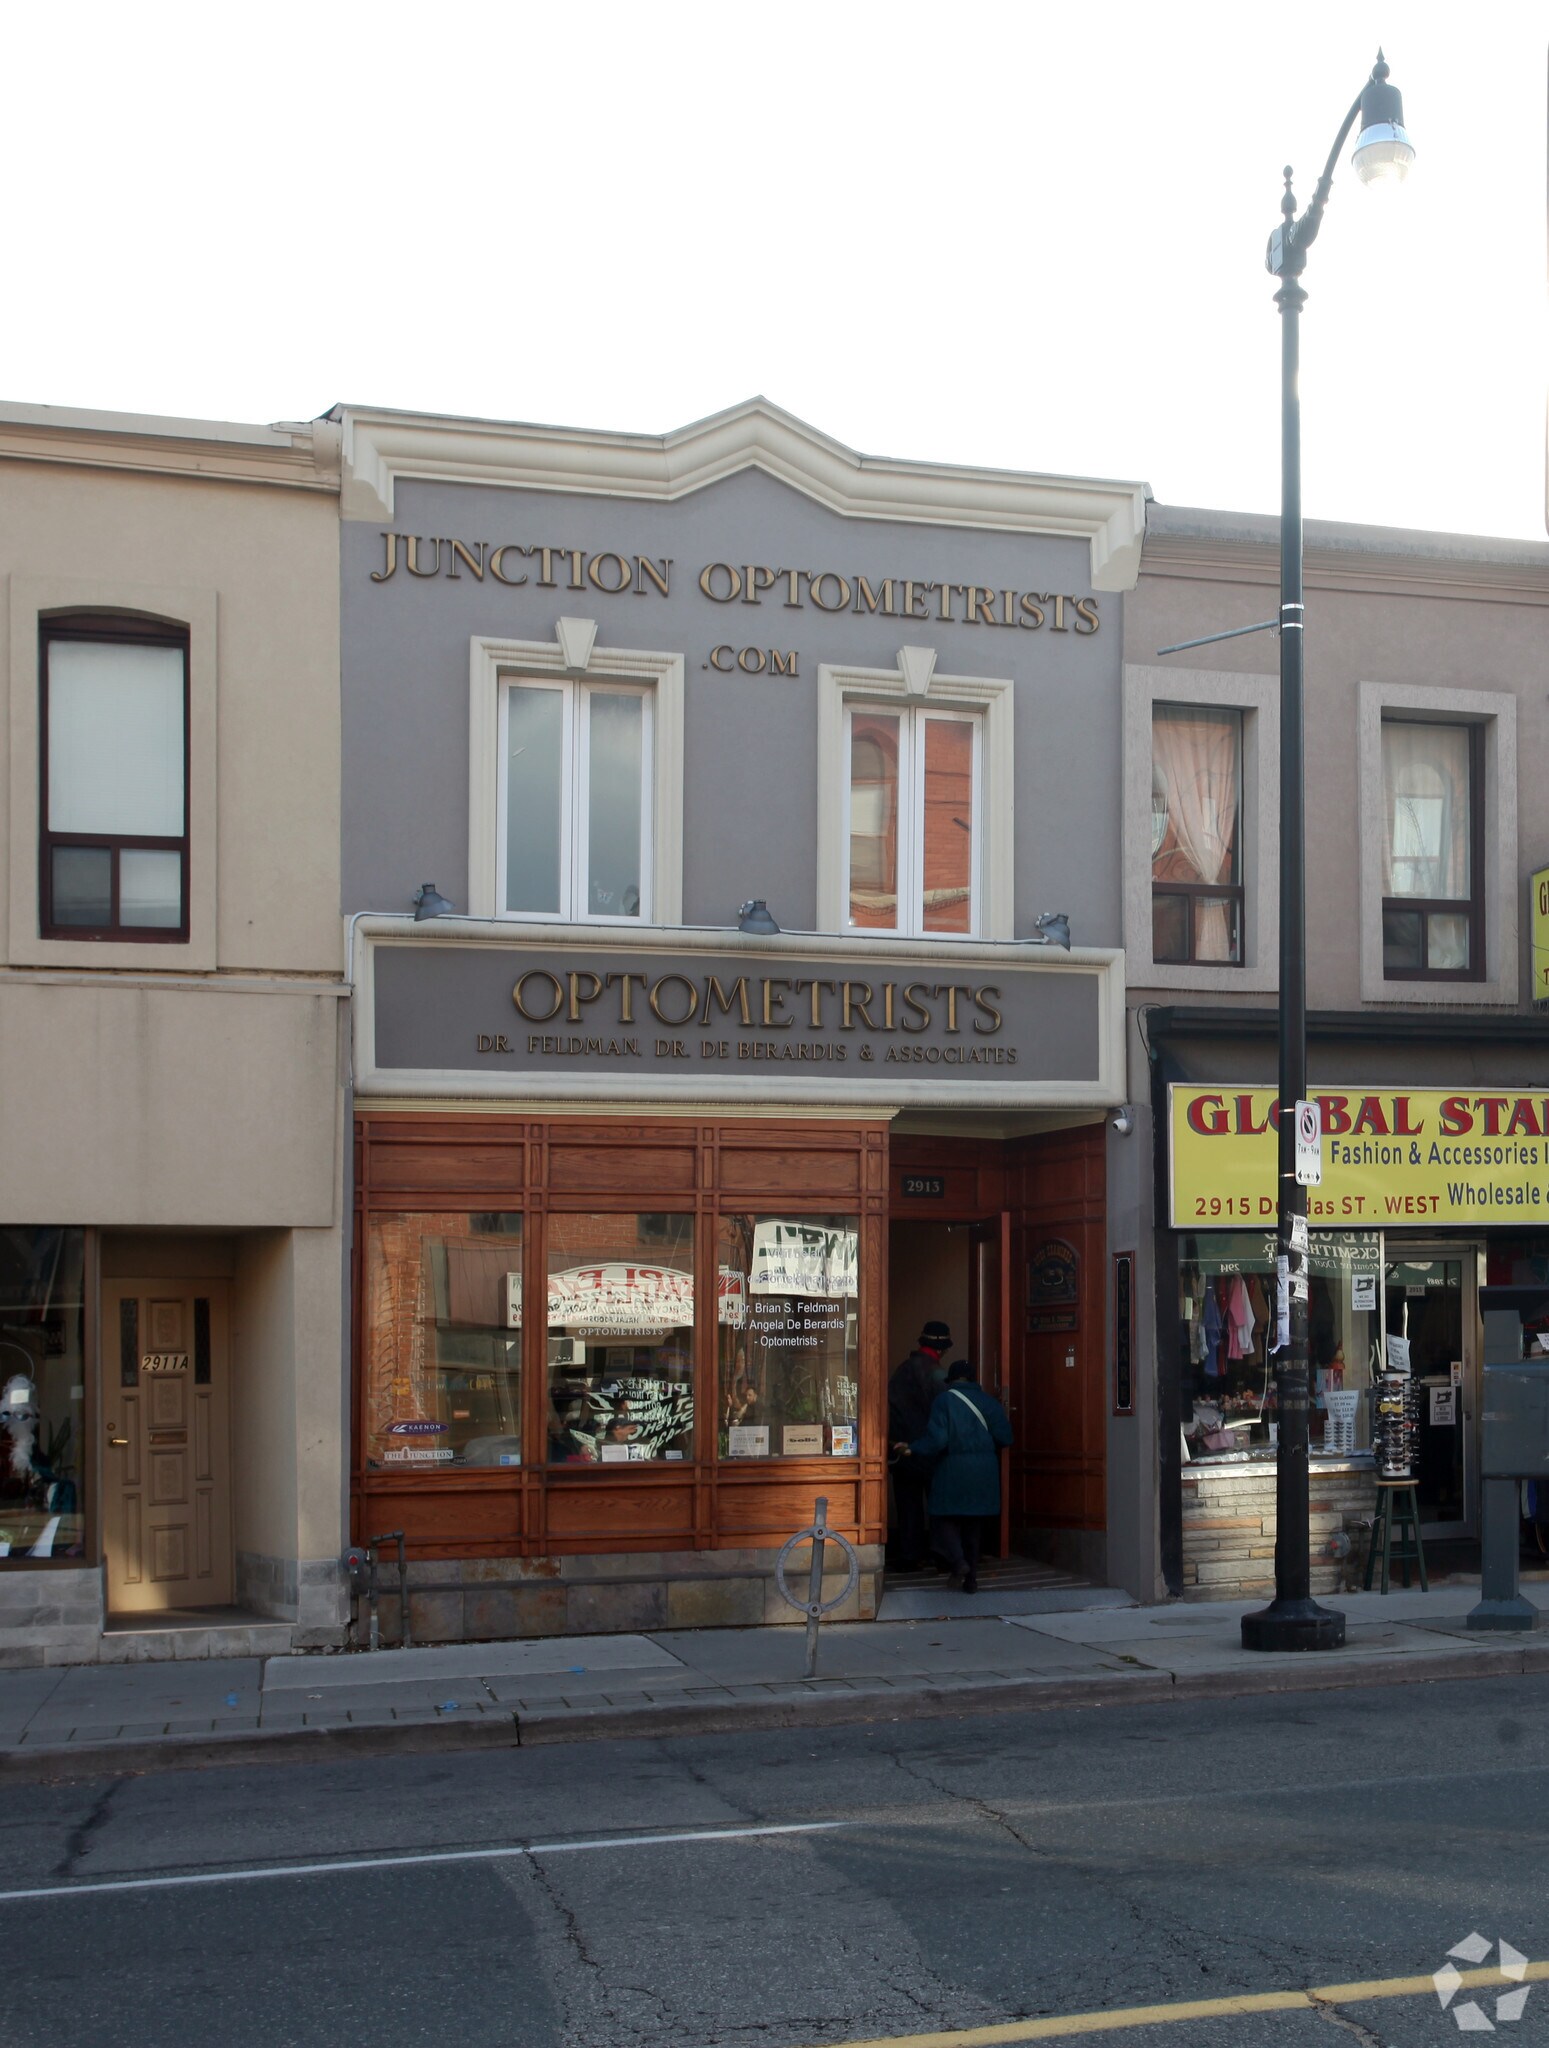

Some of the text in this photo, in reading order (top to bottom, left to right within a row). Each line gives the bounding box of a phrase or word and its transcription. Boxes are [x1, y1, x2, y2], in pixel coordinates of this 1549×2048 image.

[371, 531, 1101, 635] JUNCTION OPTOMETRISTS
[702, 644, 800, 677] .COM
[513, 969, 1003, 1034] OPTOMETRISTS
[477, 1034, 514, 1053] DR.
[655, 1039, 690, 1058] DR.
[702, 1040, 729, 1059] DE
[738, 1041, 847, 1061] BERARDIS
[860, 1043, 874, 1061] &
[886, 1045, 1018, 1064] ASSOCIATES
[1187, 1095, 1549, 1136] GLBAL STA
[1331, 1141, 1402, 1165] Fashion
[1409, 1141, 1421, 1165] &
[1428, 1141, 1538, 1165] Accessories
[907, 1180, 940, 1192] 2913
[1447, 1182, 1540, 1206] Wholesale
[1195, 1197, 1250, 1215] 2915
[1259, 1196, 1334, 1215] Ddas
[1342, 1196, 1365, 1214] ST
[1384, 1196, 1440, 1214] WEST
[737, 1303, 751, 1313] Dr.
[755, 1302, 781, 1313] Brian
[784, 1303, 794, 1313] S.
[797, 1302, 839, 1313] Feldman
[579, 1327, 664, 1336] OPTOMETRISTS
[733, 1319, 845, 1332] Dr. Angela De Berardis
[760, 1335, 818, 1348] Optometrists
[142, 1355, 189, 1371] 2911A
[387, 1450, 452, 1460] THE JUNCTION
